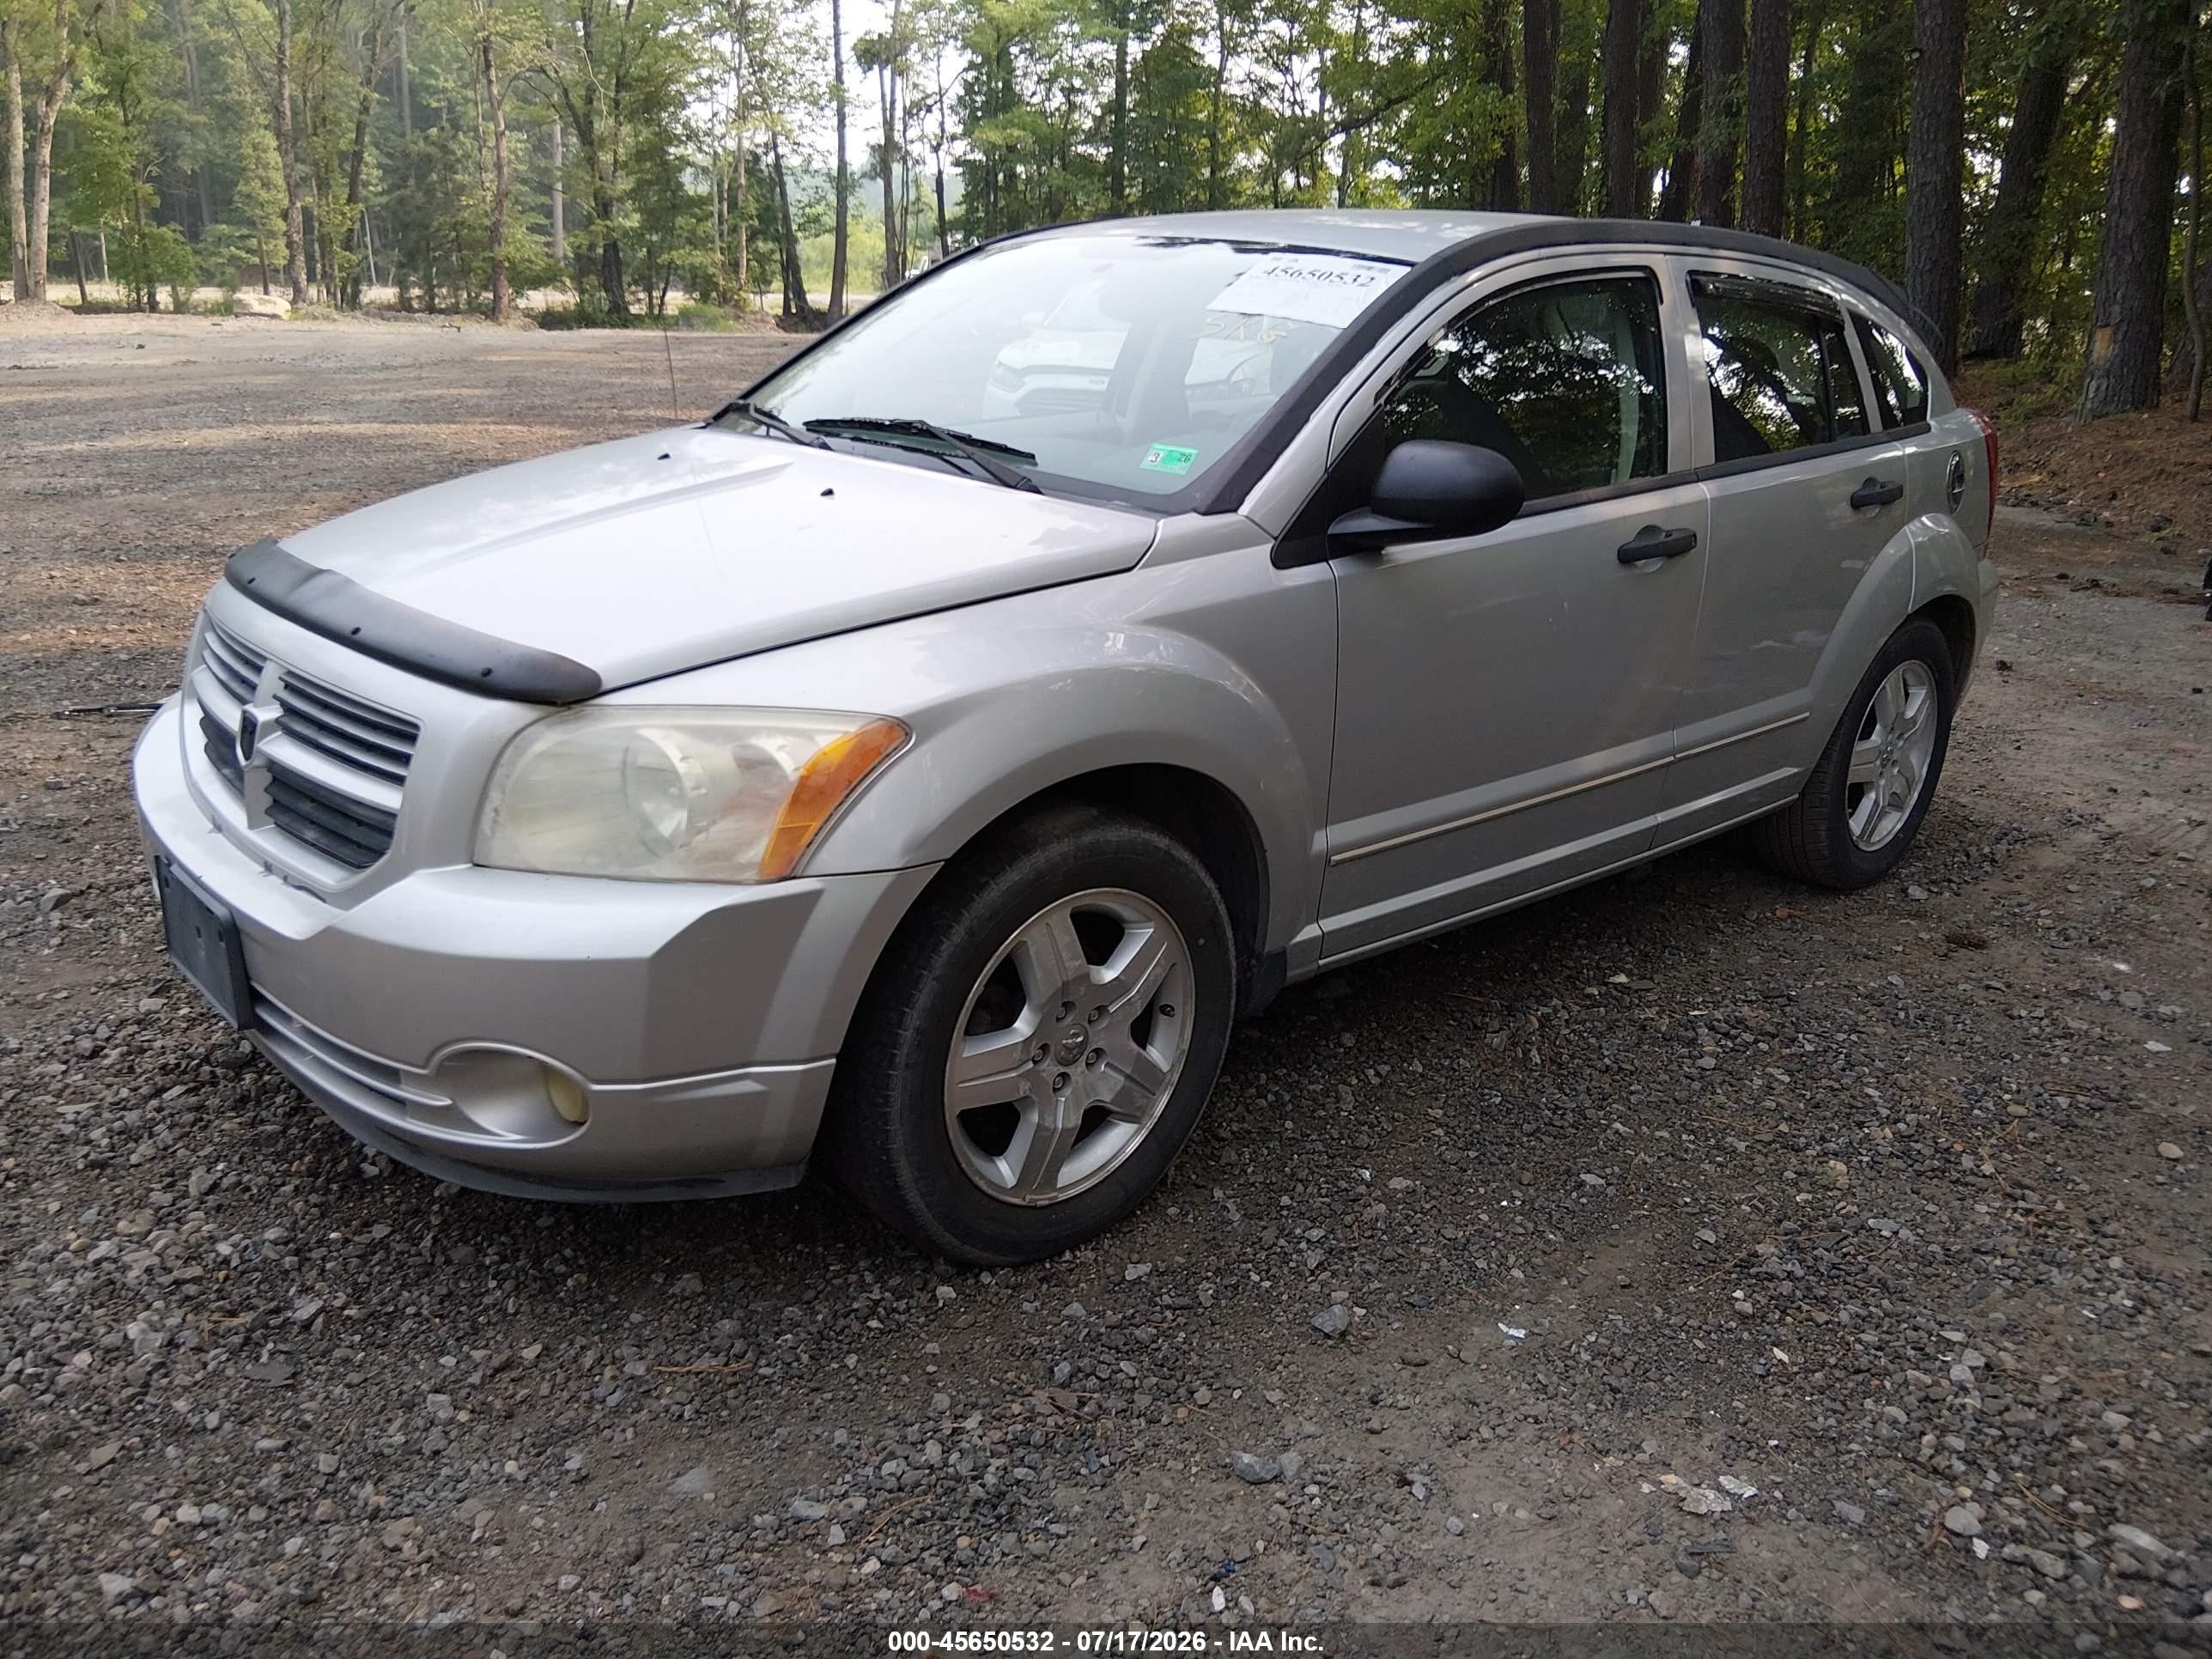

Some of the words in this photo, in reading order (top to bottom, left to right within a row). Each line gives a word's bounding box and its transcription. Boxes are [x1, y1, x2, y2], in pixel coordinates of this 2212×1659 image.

[1262, 266, 1376, 287] 45650532
[1150, 453, 1161, 464] 3
[1177, 453, 1192, 464] 26
